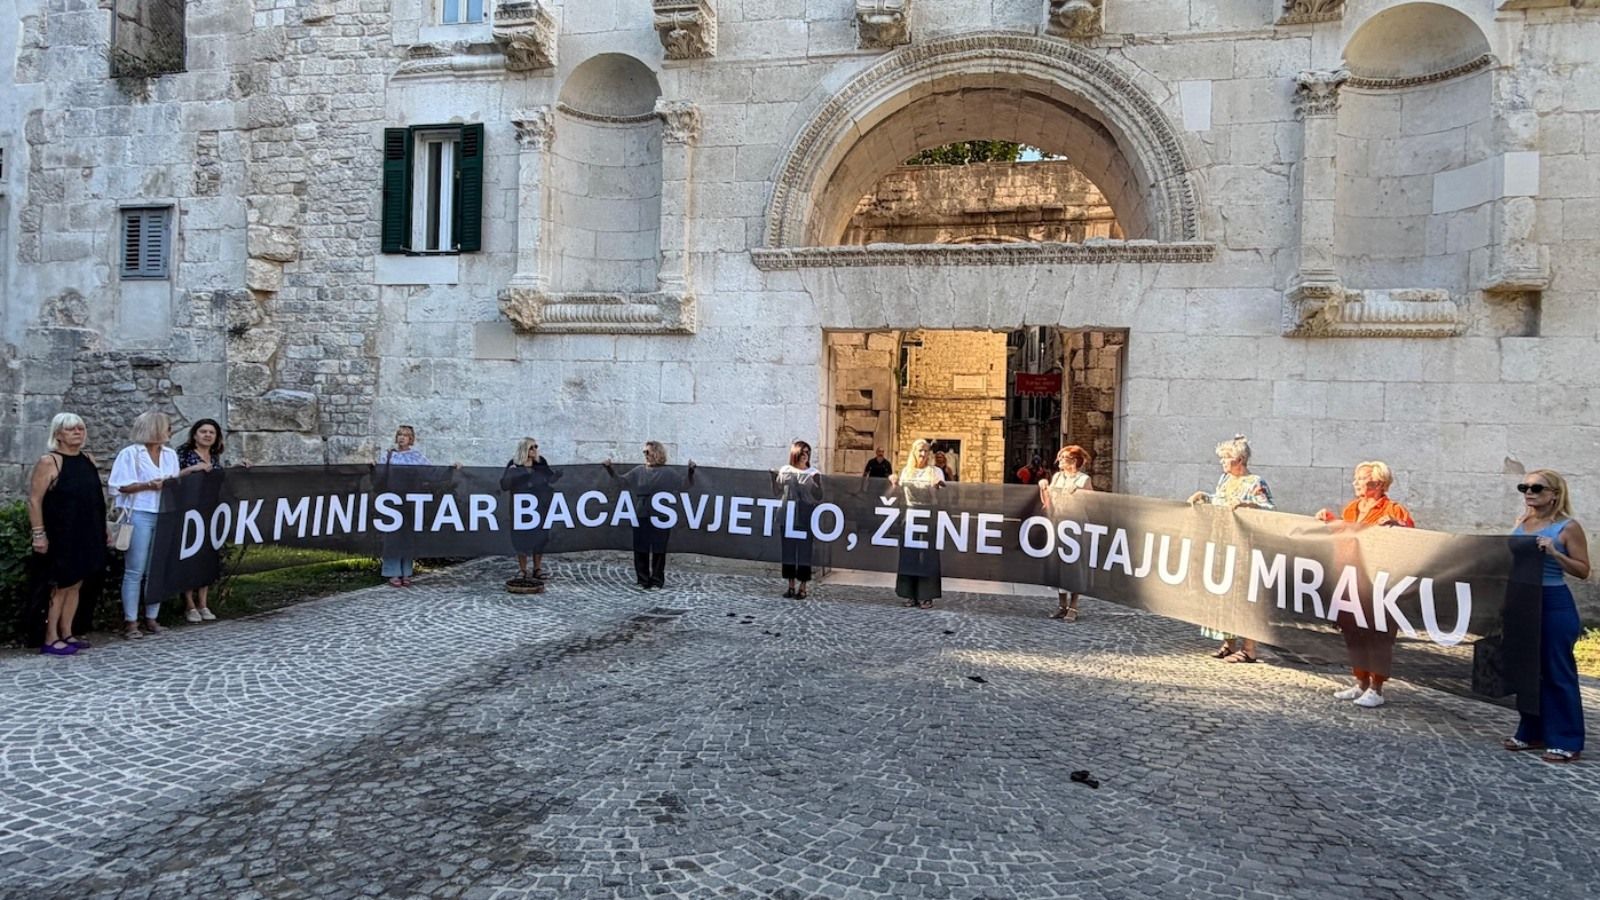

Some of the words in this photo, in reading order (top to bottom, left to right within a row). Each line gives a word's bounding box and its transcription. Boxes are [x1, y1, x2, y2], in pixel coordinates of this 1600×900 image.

[179, 498, 265, 561] DOK
[273, 492, 499, 541] MINISTAR
[512, 490, 640, 531] BACA
[650, 491, 859, 550] SVJETLO,
[871, 495, 1005, 554] ŽENE
[1018, 515, 1192, 585] OSTAJU
[1202, 541, 1236, 595] U
[1247, 549, 1472, 647] MRAKU
